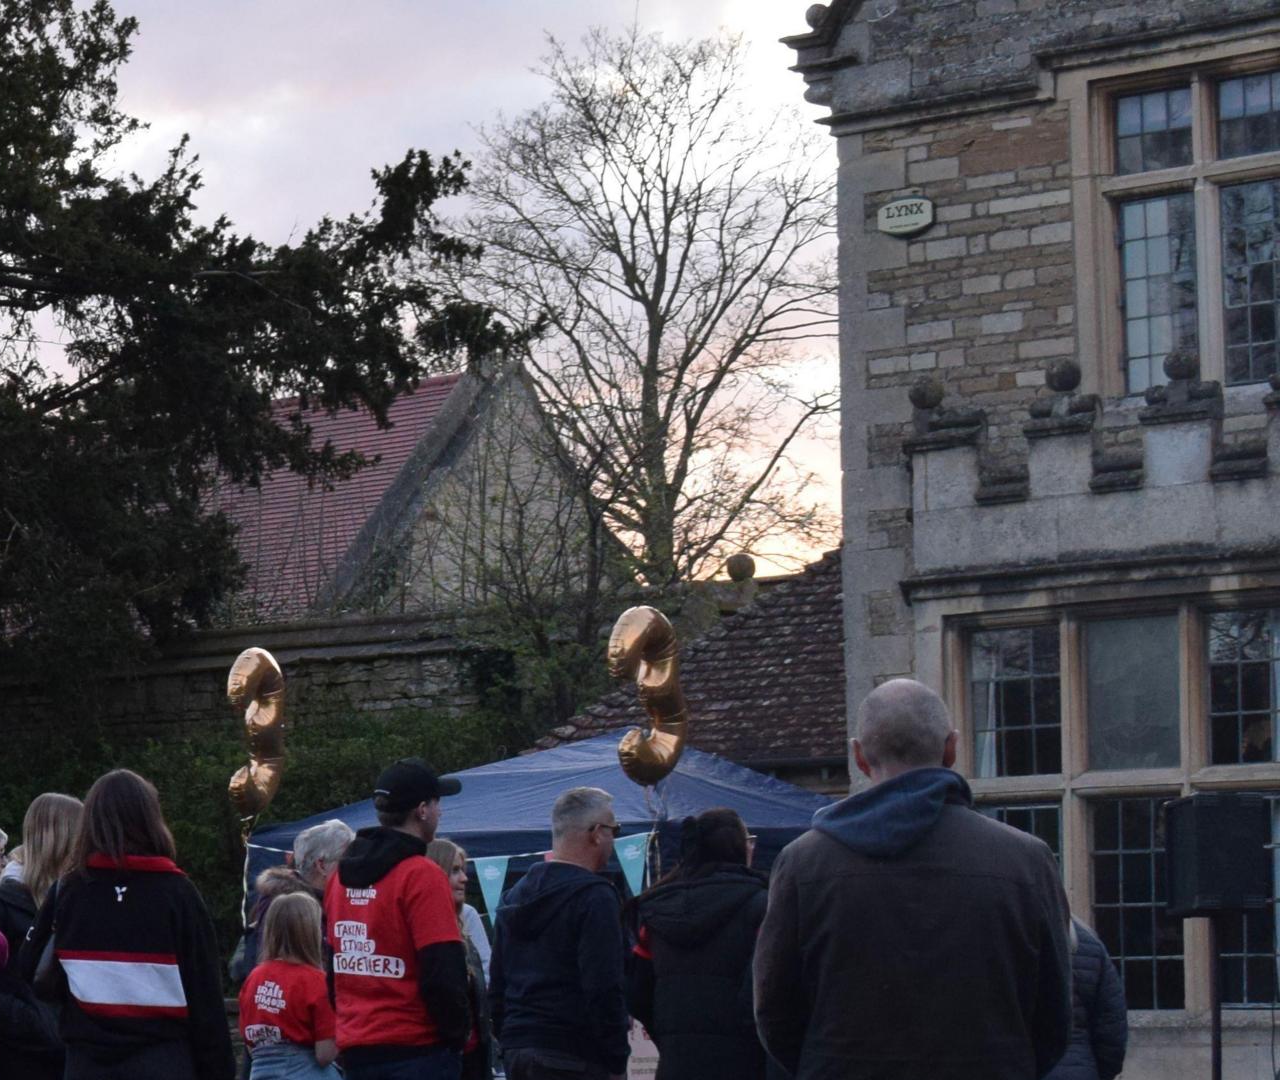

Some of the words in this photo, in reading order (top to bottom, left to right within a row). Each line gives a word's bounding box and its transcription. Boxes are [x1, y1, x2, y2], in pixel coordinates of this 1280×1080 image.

[886, 202, 924, 219] LYNX
[336, 923, 366, 937] TAKING
[343, 940, 371, 953] STRIDES
[335, 955, 401, 976] TOGETHER!
